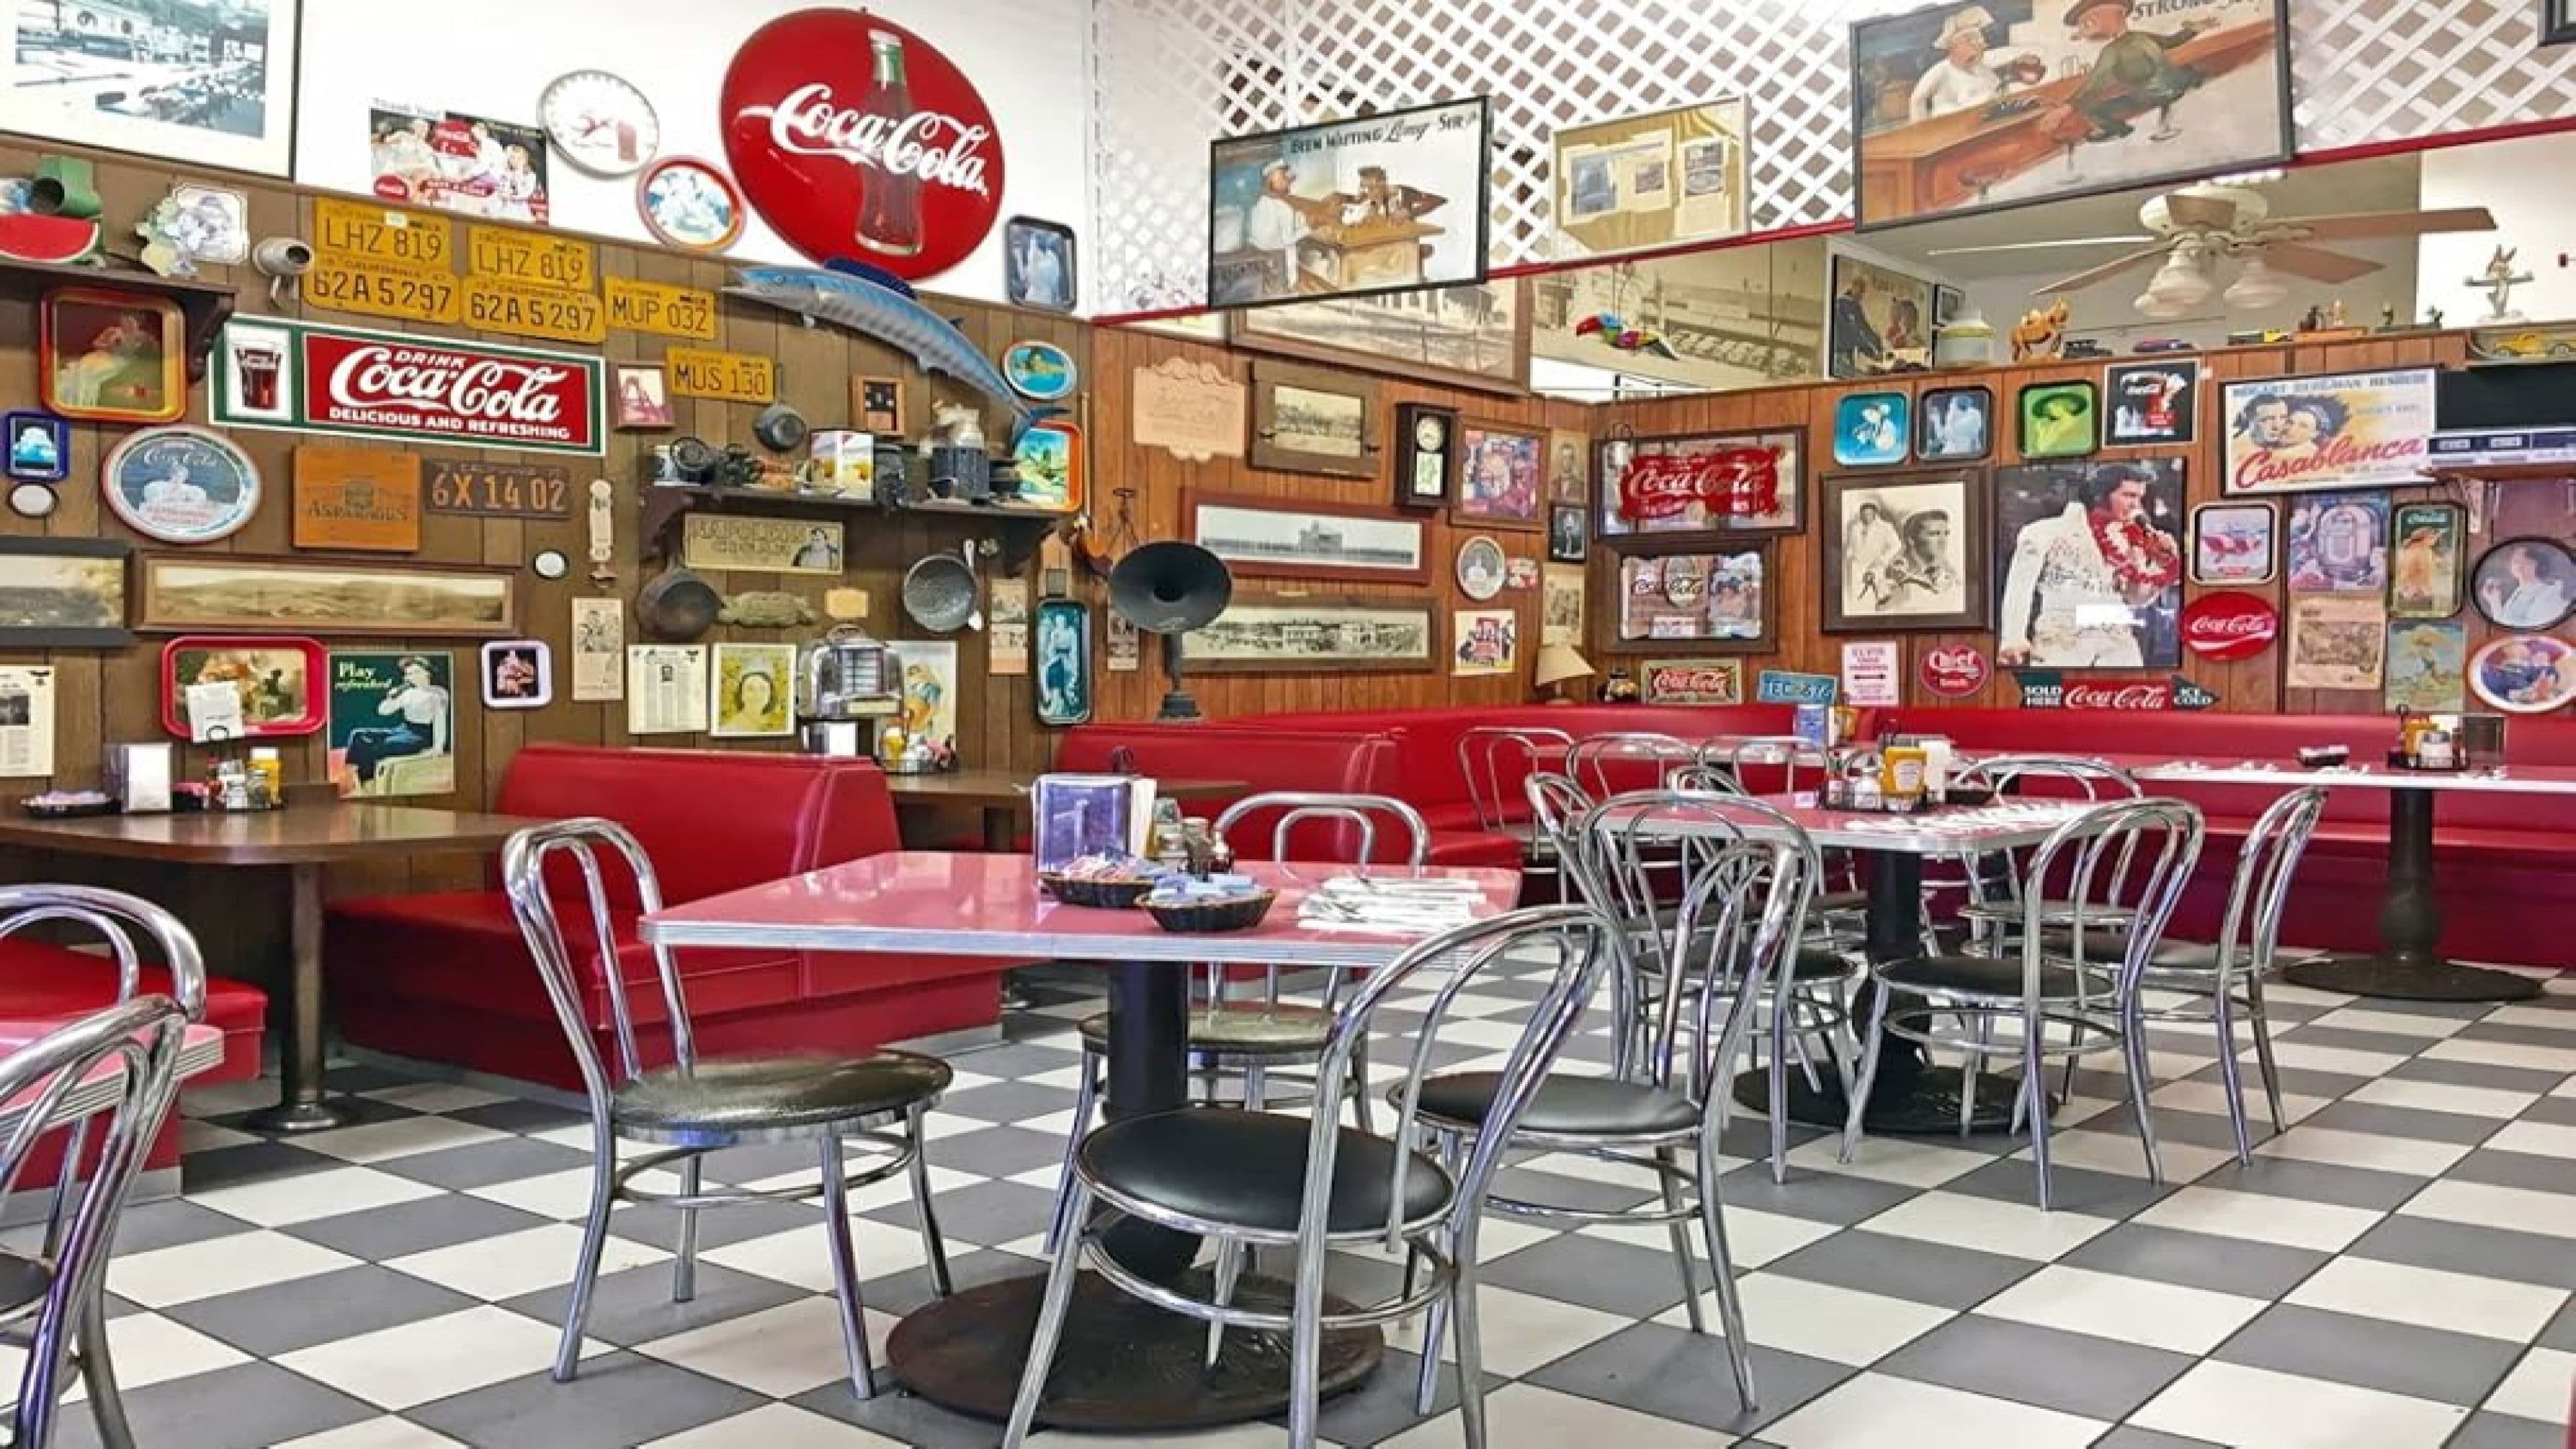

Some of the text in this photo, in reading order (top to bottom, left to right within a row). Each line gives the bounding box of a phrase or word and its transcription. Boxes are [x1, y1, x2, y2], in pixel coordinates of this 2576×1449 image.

[737, 83, 989, 192] Coca-Cola
[326, 217, 384, 254] LHZ
[394, 228, 441, 262] 819
[477, 244, 584, 284] LHZ 819
[613, 294, 707, 332] MUP 032
[393, 351, 468, 370] DRINK
[329, 347, 568, 421] Coca-Cola
[674, 363, 765, 395] MUS 130
[329, 407, 570, 441] DELICIOUS AND REFRESHING
[2236, 435, 2424, 489] Casablanca
[2192, 611, 2273, 633] Coca-Cola
[339, 661, 376, 680] Play
[1653, 669, 1729, 694] Coca-Cola
[2025, 685, 2063, 696] SOLD
[2026, 696, 2061, 707] HERE
[2065, 685, 2167, 709] Coca-Cola
